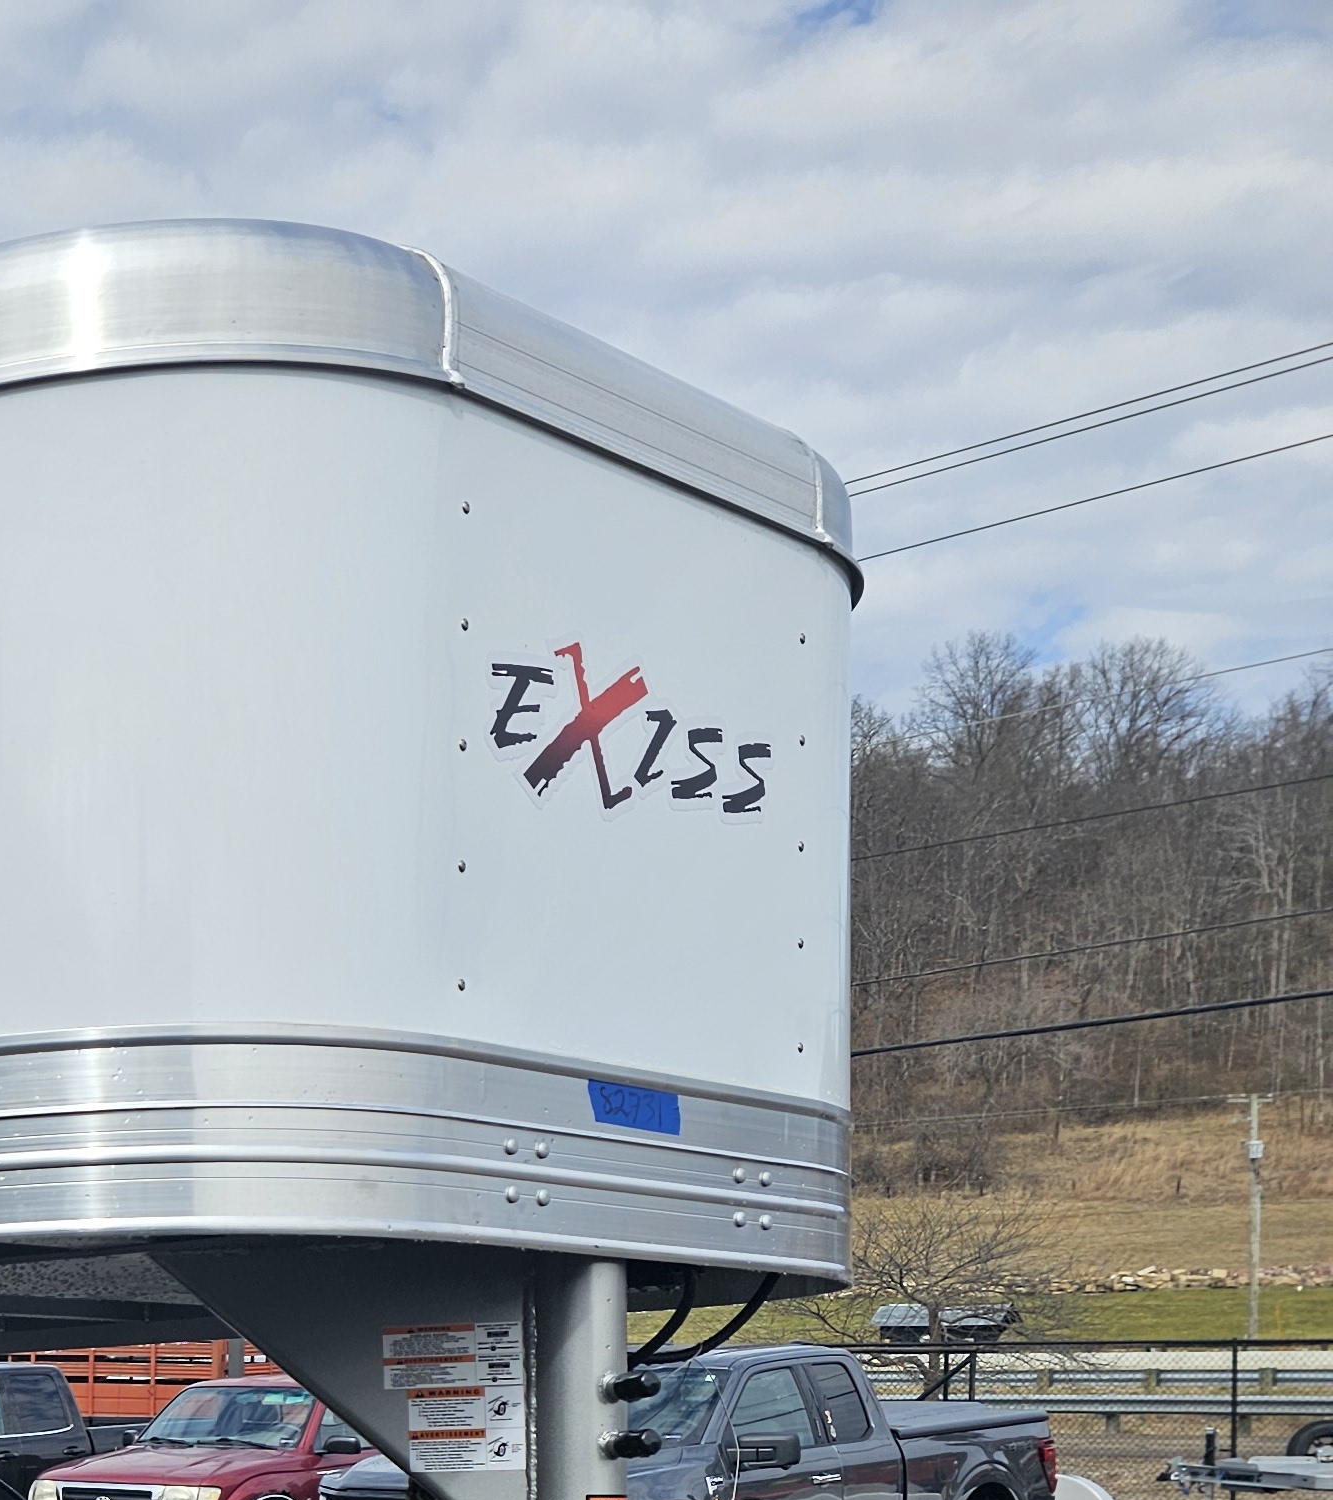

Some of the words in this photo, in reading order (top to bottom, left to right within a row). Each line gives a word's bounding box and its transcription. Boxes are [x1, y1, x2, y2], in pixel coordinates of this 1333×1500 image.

[490, 641, 772, 814] EXISS
[599, 1085, 662, 1128] 82731
[428, 1389, 481, 1397] WARNING
[420, 1429, 485, 1439] AVERTISSEMENT
